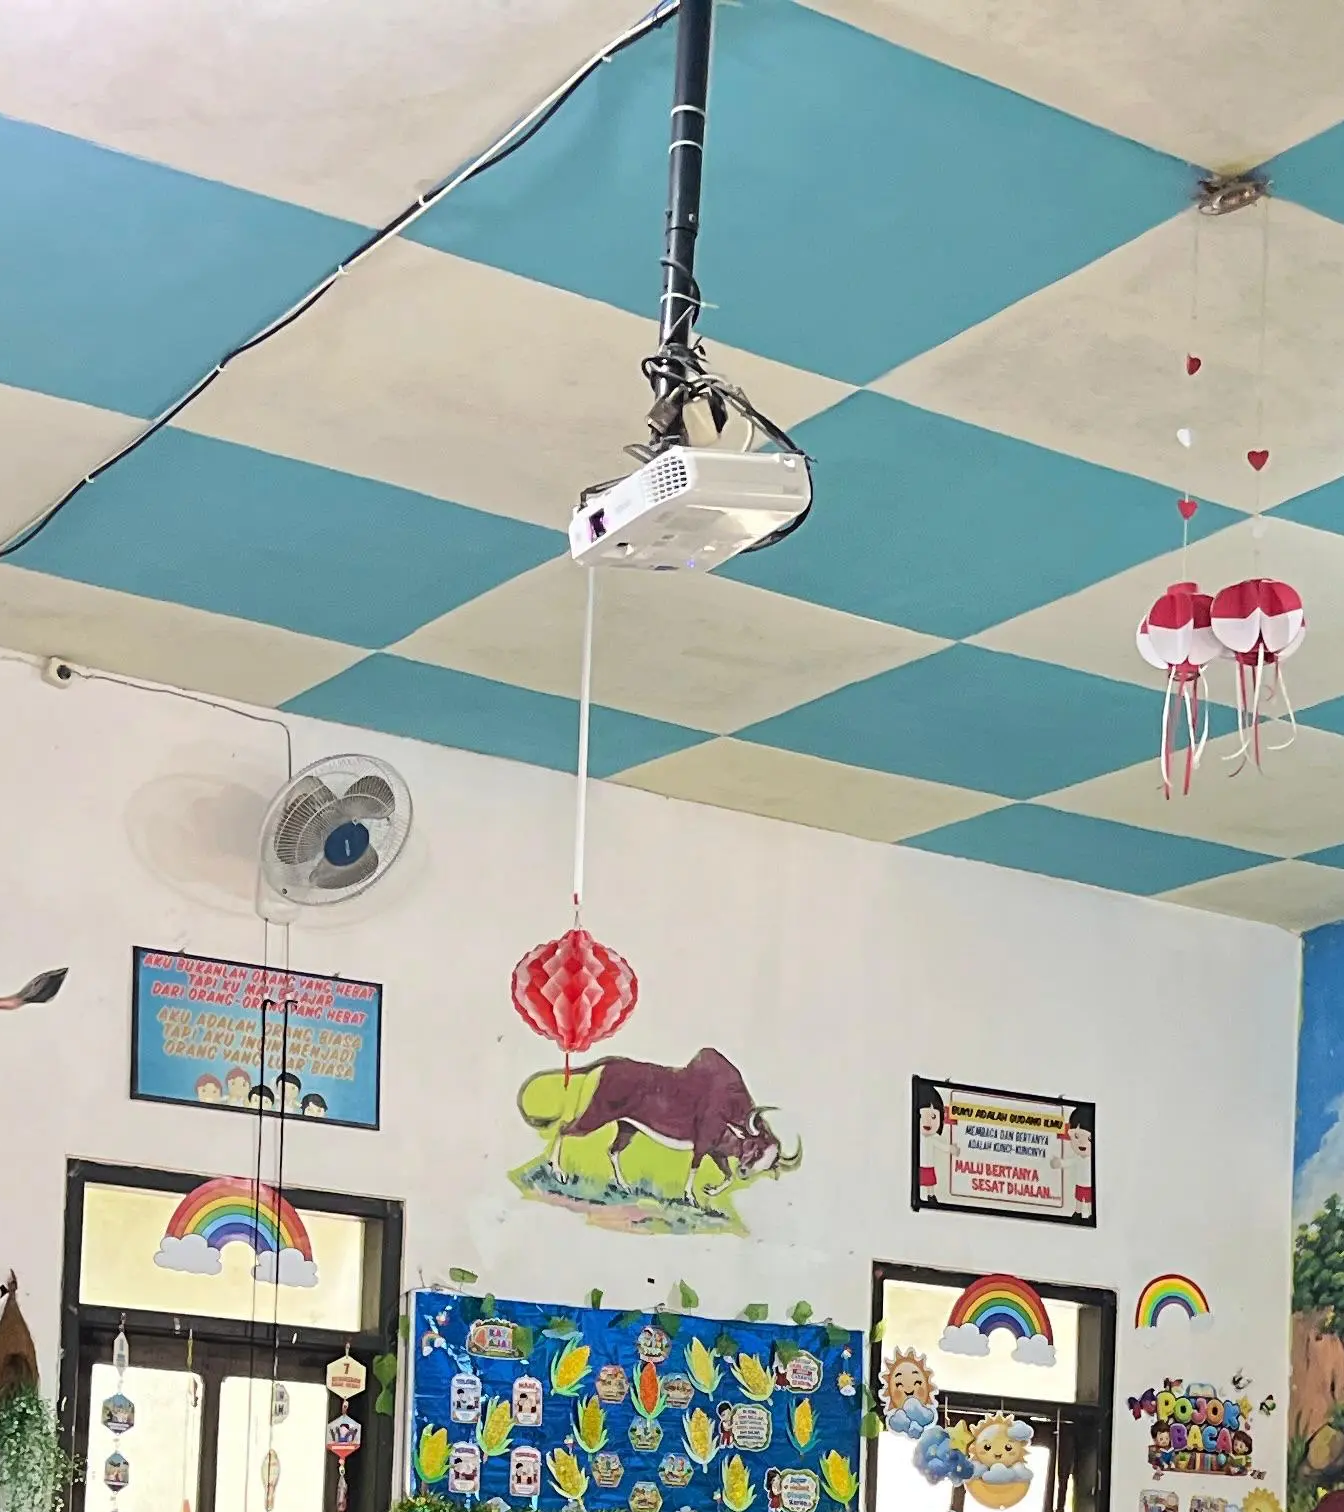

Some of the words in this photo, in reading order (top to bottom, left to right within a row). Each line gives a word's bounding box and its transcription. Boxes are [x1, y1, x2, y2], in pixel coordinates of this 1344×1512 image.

[144, 954, 172, 968] AKU
[176, 958, 247, 979] BUKANLAH
[253, 970, 295, 988] ORANG
[300, 978, 332, 993] YANG
[336, 983, 376, 1000] HEBAT
[189, 974, 218, 988] TAPI
[222, 980, 240, 993] KU
[152, 981, 184, 997] DARI
[327, 1008, 367, 1025] HEBAT
[157, 1007, 191, 1023] AKU
[197, 1013, 256, 1032] ADALAH
[163, 1022, 197, 1039] TAPI
[203, 1029, 235, 1046] AKU
[289, 1041, 355, 1061] MENJADI
[163, 1040, 217, 1060] ORANG
[223, 1048, 261, 1066] YANG
[311, 1062, 354, 1080] BIASA
[975, 1109, 1008, 1121] ADALAH
[1000, 1129, 1014, 1140] DAN
[1015, 1131, 1049, 1145] BERTANYA
[955, 1160, 983, 1175] MALU
[985, 1163, 1040, 1182] BERTANYA
[971, 1178, 1006, 1193] SESAT
[343, 1363, 350, 1374] 7
[1156, 1391, 1241, 1431] POJOK
[1170, 1423, 1233, 1454] BACA
